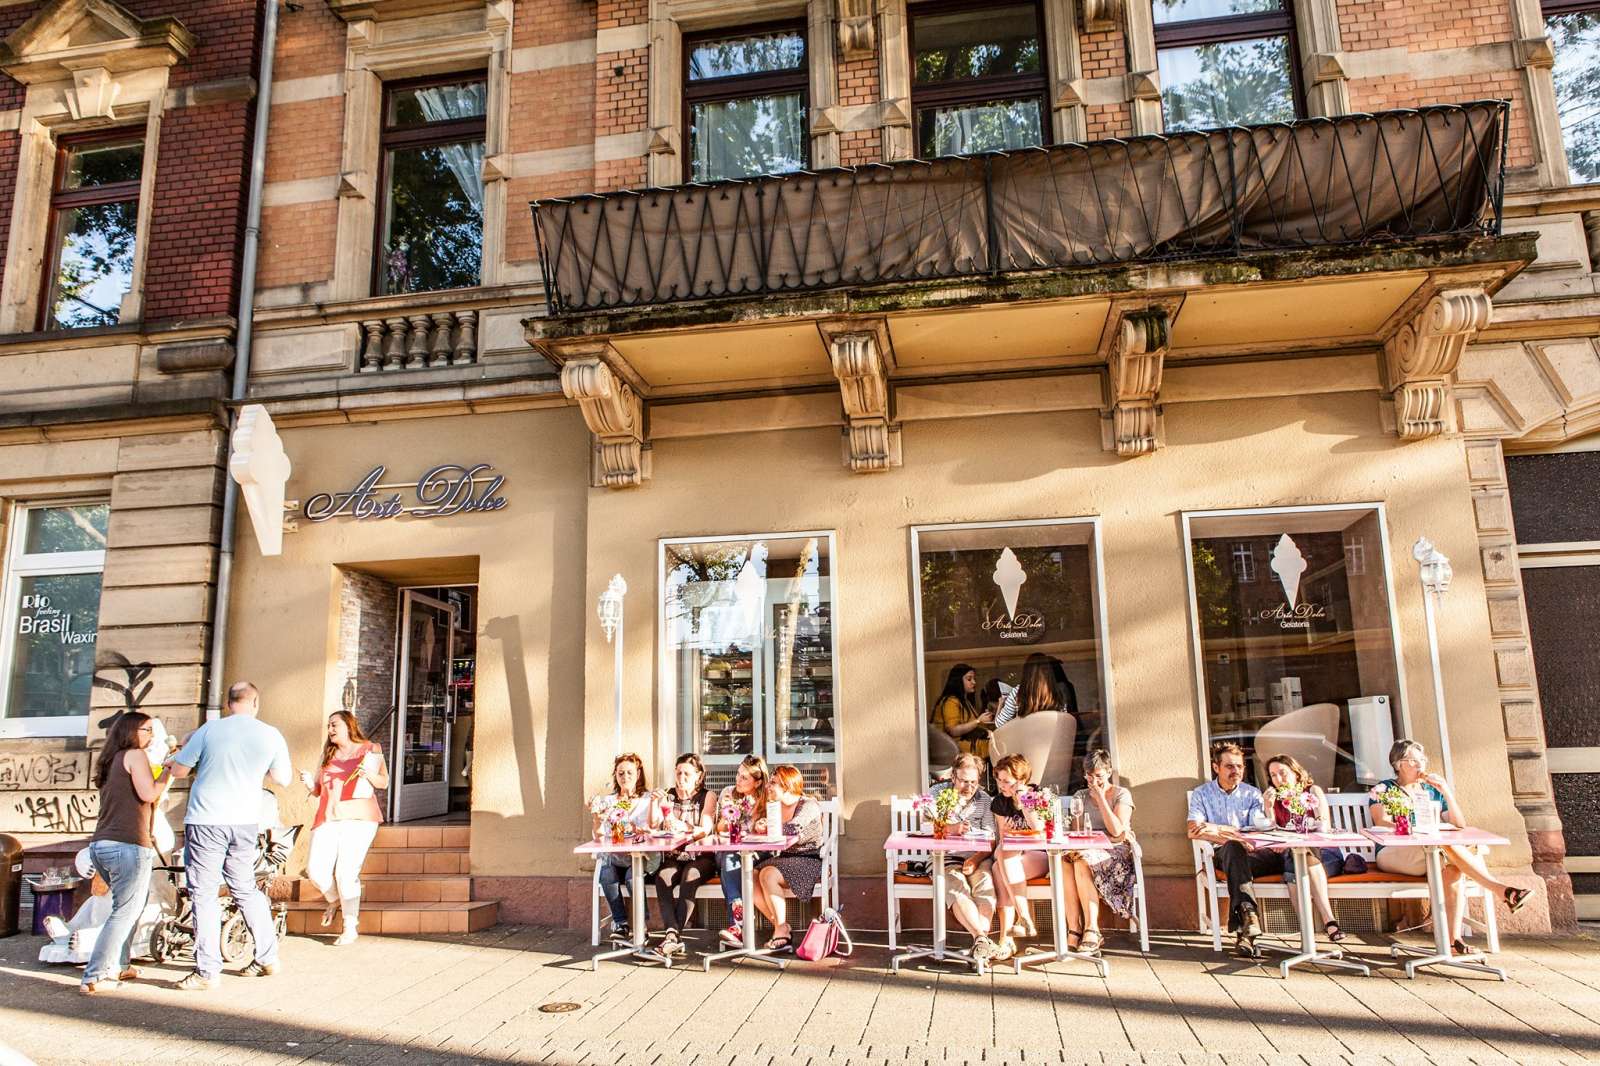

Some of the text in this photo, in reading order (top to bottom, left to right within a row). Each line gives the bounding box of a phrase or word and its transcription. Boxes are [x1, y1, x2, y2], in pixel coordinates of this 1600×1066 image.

[304, 464, 507, 522] Arte Dolce
[22, 594, 50, 609] Rio
[1260, 602, 1326, 619] Arte Dolce
[19, 613, 71, 634] Brasil
[981, 613, 1042, 630] Arte Dolce
